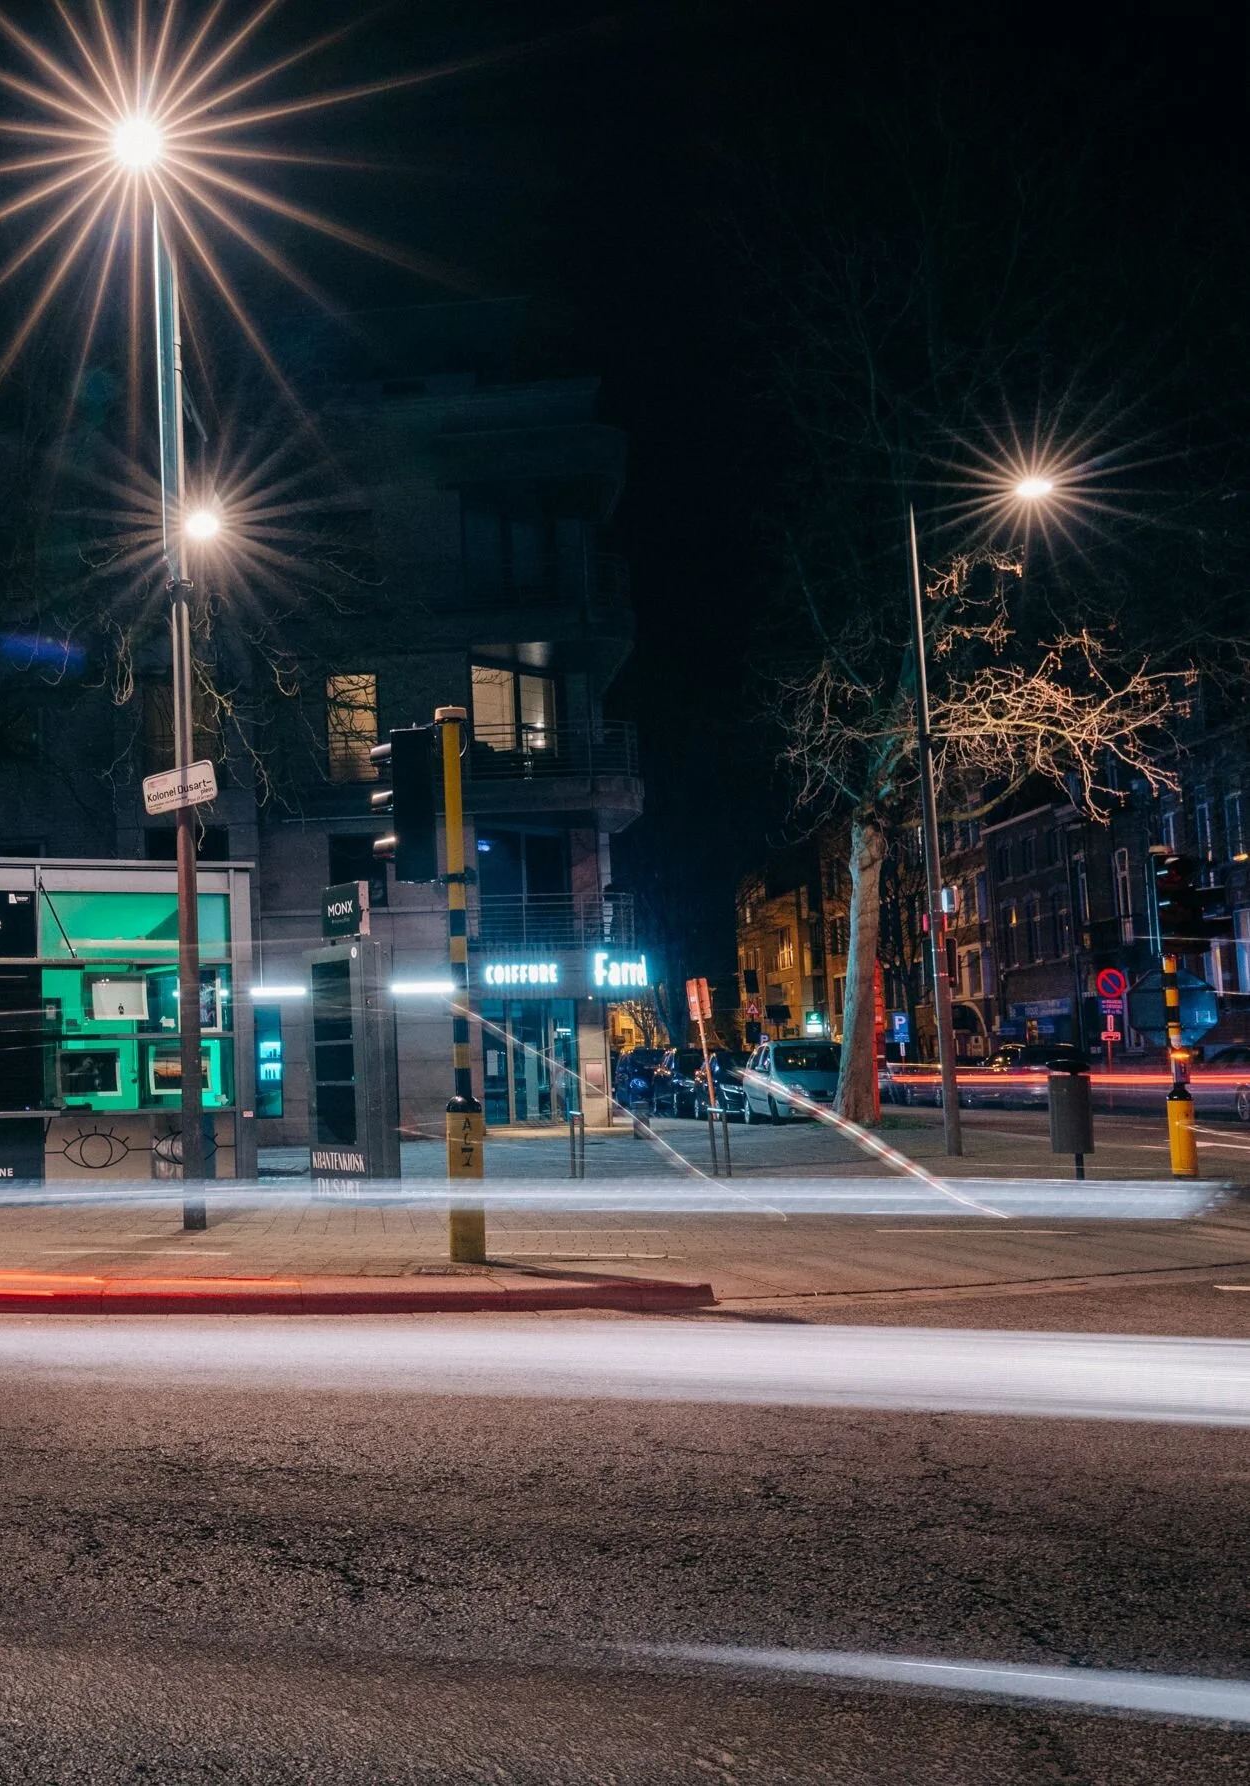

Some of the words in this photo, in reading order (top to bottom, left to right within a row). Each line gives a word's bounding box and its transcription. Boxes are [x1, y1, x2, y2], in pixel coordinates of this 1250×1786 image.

[147, 787, 177, 803] Kolonel
[200, 787, 214, 796] plein
[328, 900, 353, 917] MONX
[485, 963, 558, 985] COIFFURE
[894, 1015, 906, 1030] P
[312, 1151, 366, 1173] KRANTENKIOSK
